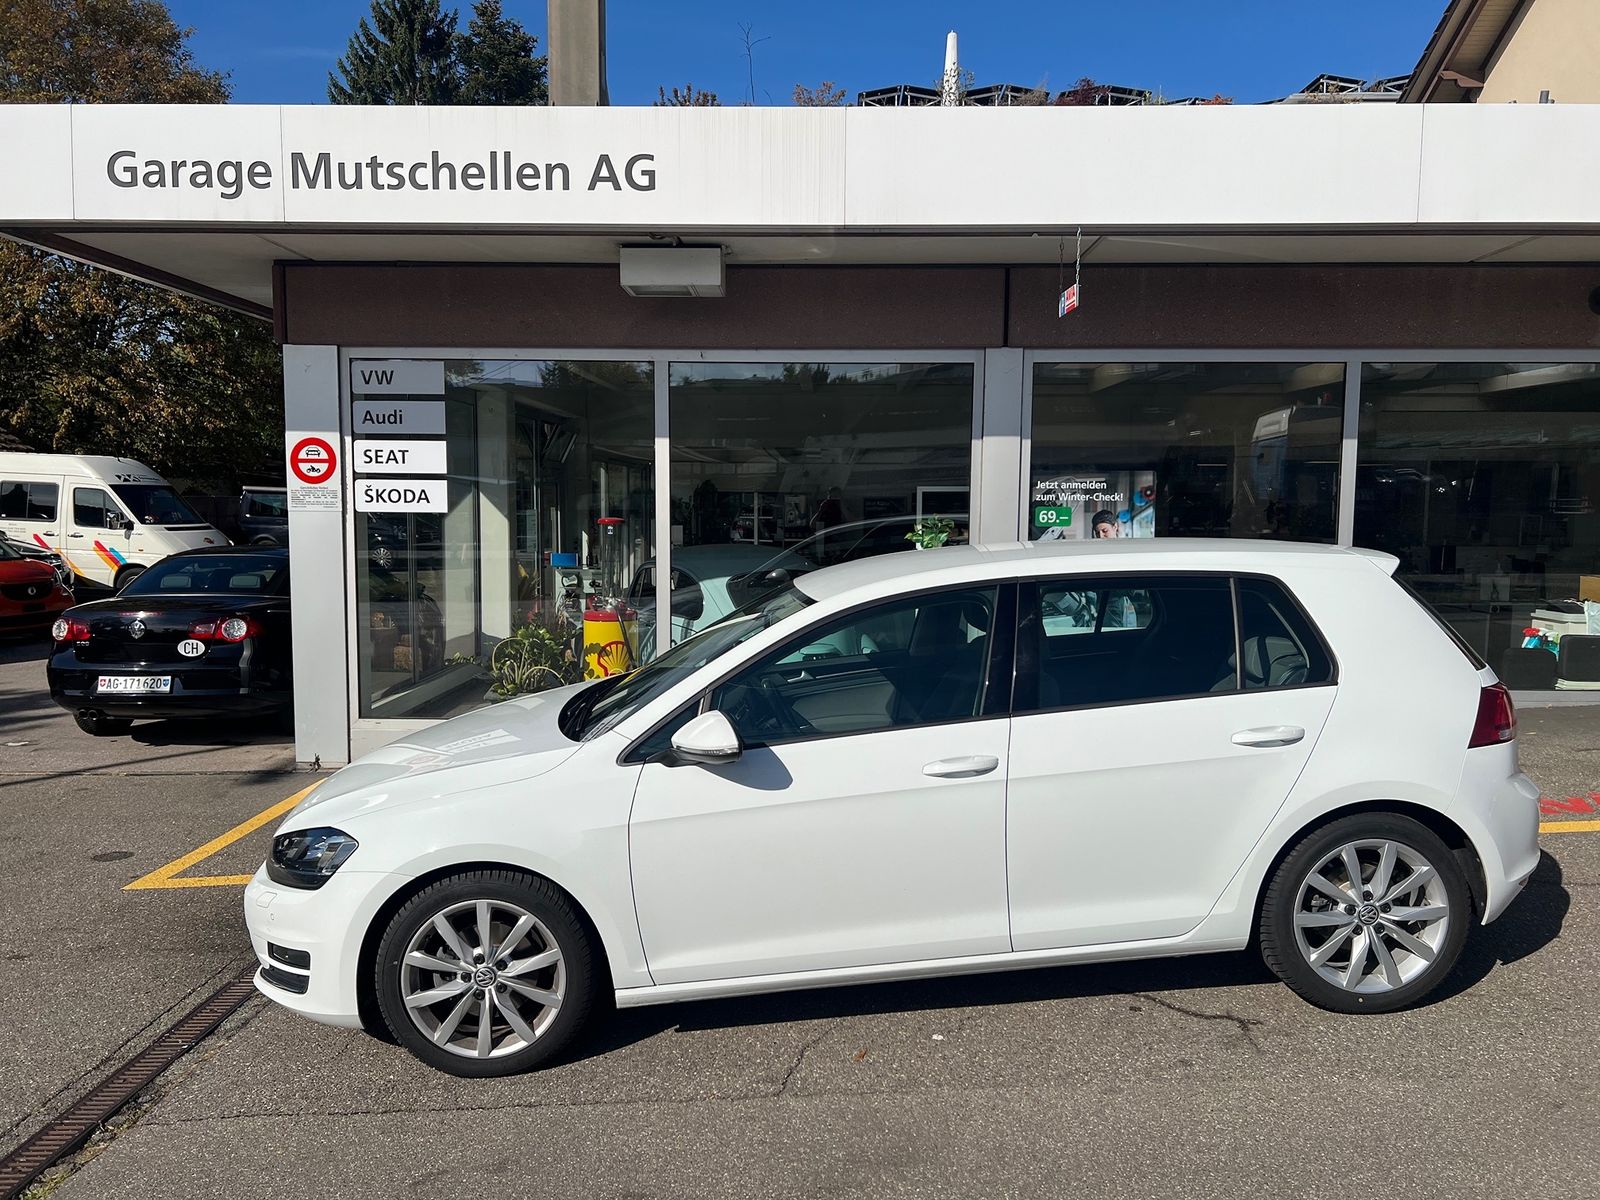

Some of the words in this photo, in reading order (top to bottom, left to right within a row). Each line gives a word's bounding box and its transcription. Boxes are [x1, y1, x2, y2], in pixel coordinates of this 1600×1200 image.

[106, 150, 272, 199] Garage
[291, 151, 571, 191] Mutschellen
[588, 153, 656, 192] AG
[360, 369, 394, 385] VW
[362, 409, 403, 425] Audi
[363, 448, 409, 465] SEAT
[1036, 480, 1058, 490] Jetzt
[1061, 481, 1107, 490] anmelden
[364, 484, 431, 504] ŠKODA
[1036, 494, 1055, 502] zum
[1058, 492, 1124, 502] Winter-Check!
[184, 642, 199, 655] CH
